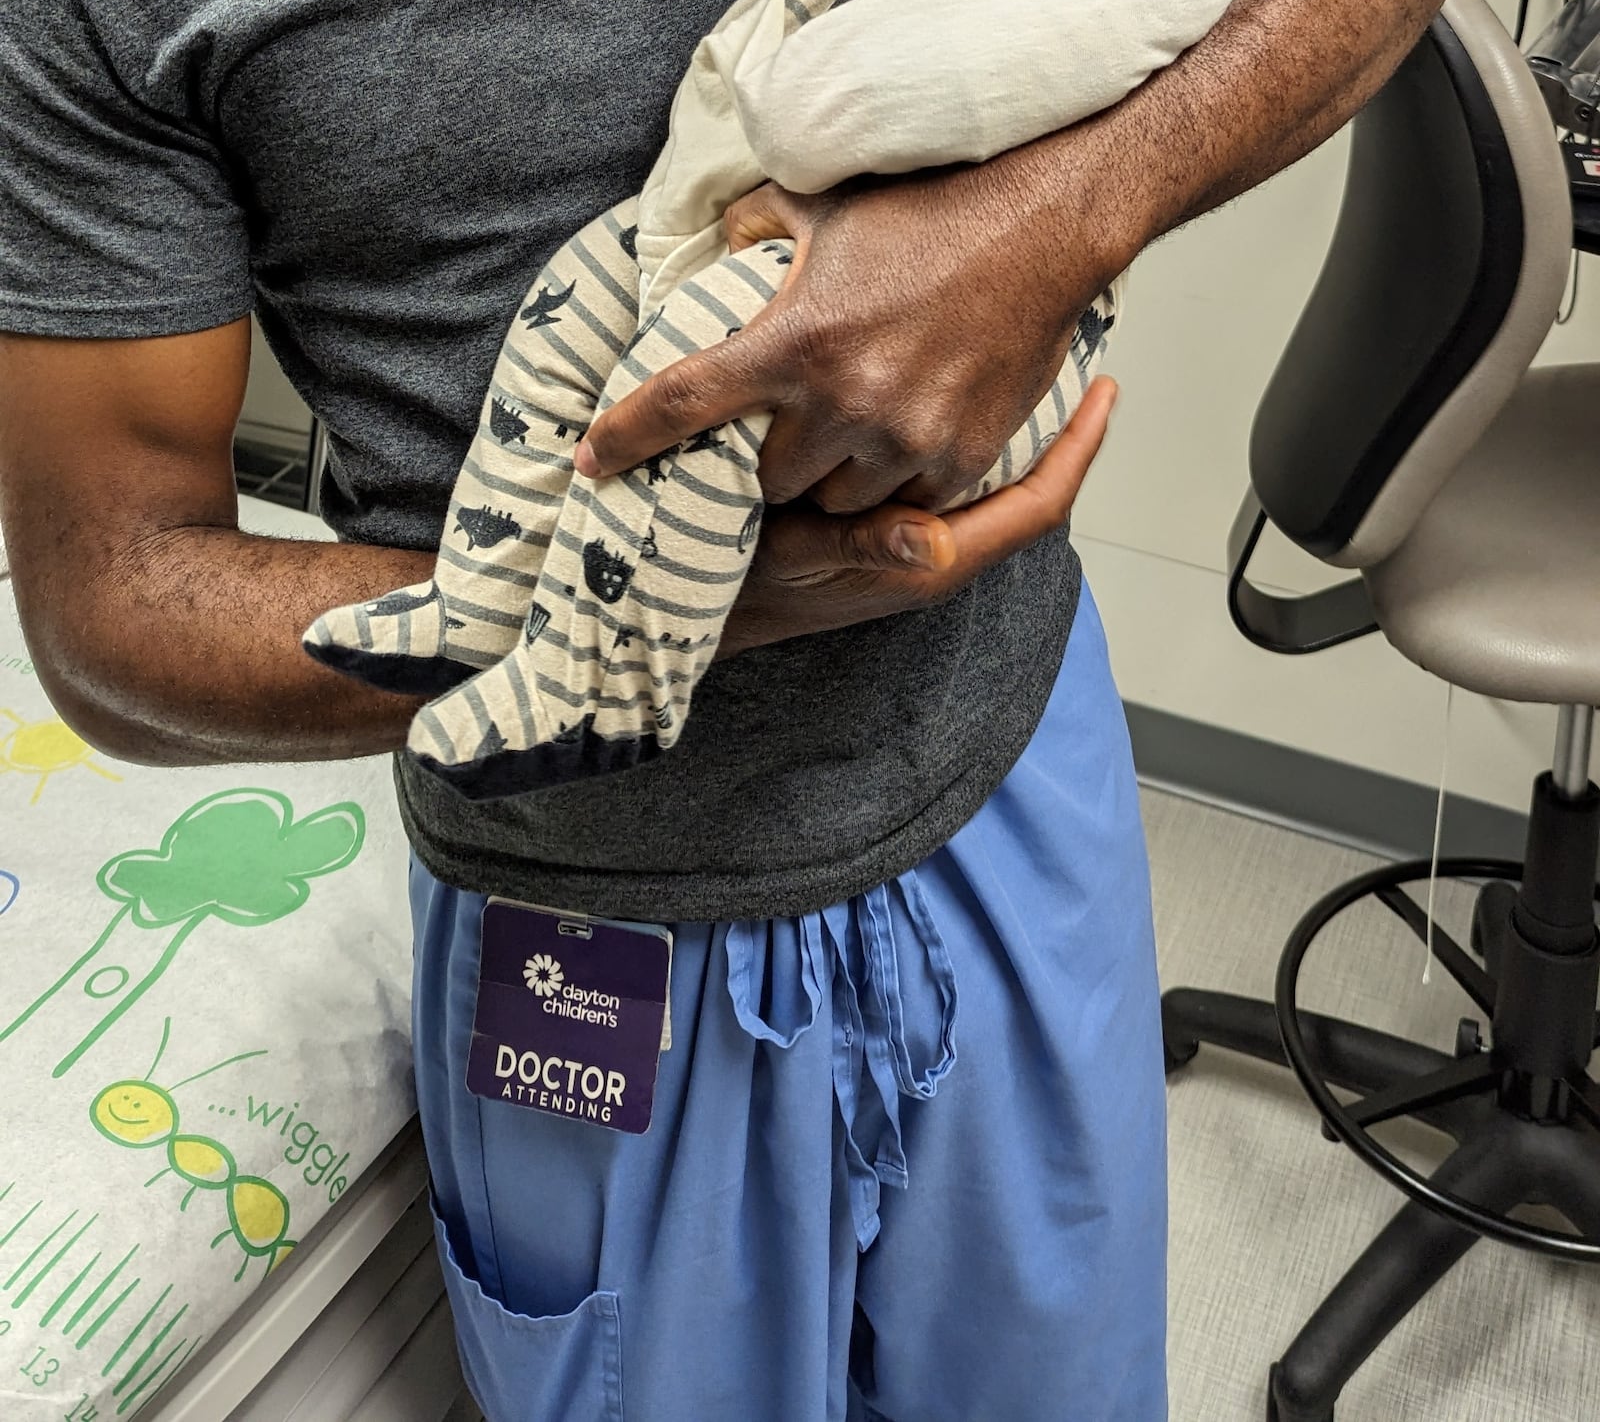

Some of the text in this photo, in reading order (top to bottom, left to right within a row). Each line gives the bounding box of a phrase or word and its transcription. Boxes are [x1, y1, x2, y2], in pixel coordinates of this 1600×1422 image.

[542, 998, 618, 1029] children's
[562, 983, 620, 1010] dayton
[495, 1044, 626, 1107] DOCTOR
[501, 1082, 612, 1123] ATTENDING
[19, 1345, 60, 1387] 13
